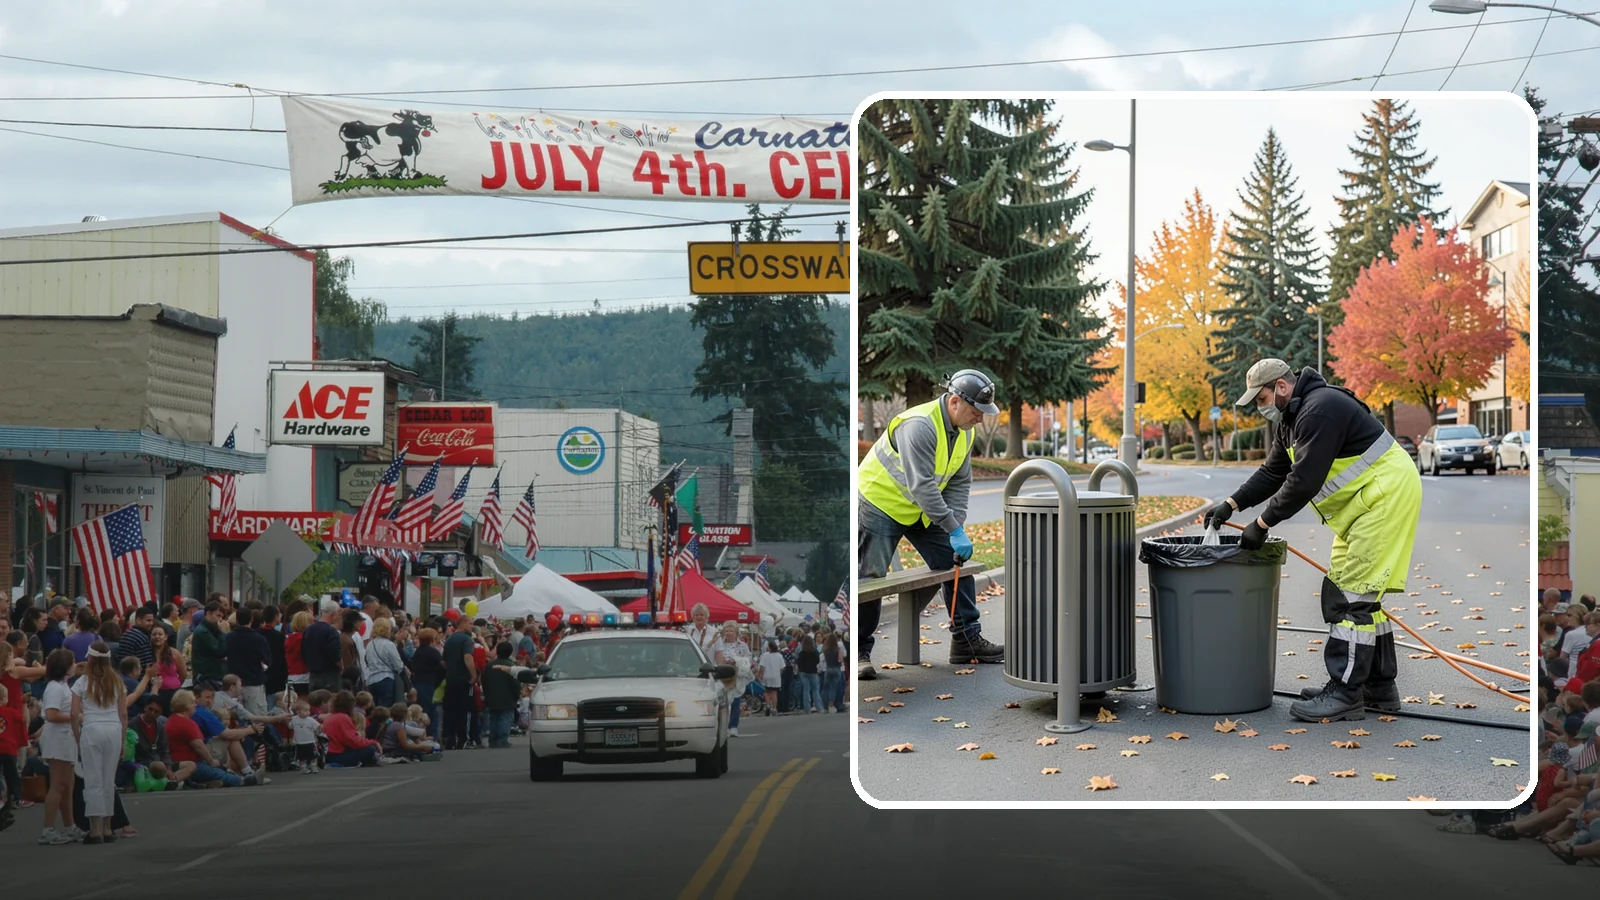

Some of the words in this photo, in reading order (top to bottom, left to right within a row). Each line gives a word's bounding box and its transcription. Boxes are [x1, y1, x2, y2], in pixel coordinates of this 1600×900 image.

[481, 140, 605, 193] JULY
[632, 150, 747, 198] 4th.
[697, 254, 850, 280] CROSSWA
[283, 380, 373, 419] ACE
[405, 408, 453, 422] CEDAR
[284, 421, 371, 436] Hardware
[416, 428, 476, 447] Coca-Cola
[353, 467, 386, 479] Simpl
[83, 485, 92, 494] St.
[95, 485, 124, 494] Vincent
[126, 486, 136, 494] de
[137, 486, 155, 495] Paul
[688, 526, 741, 535] CRNATION
[699, 535, 730, 543] GLASS
